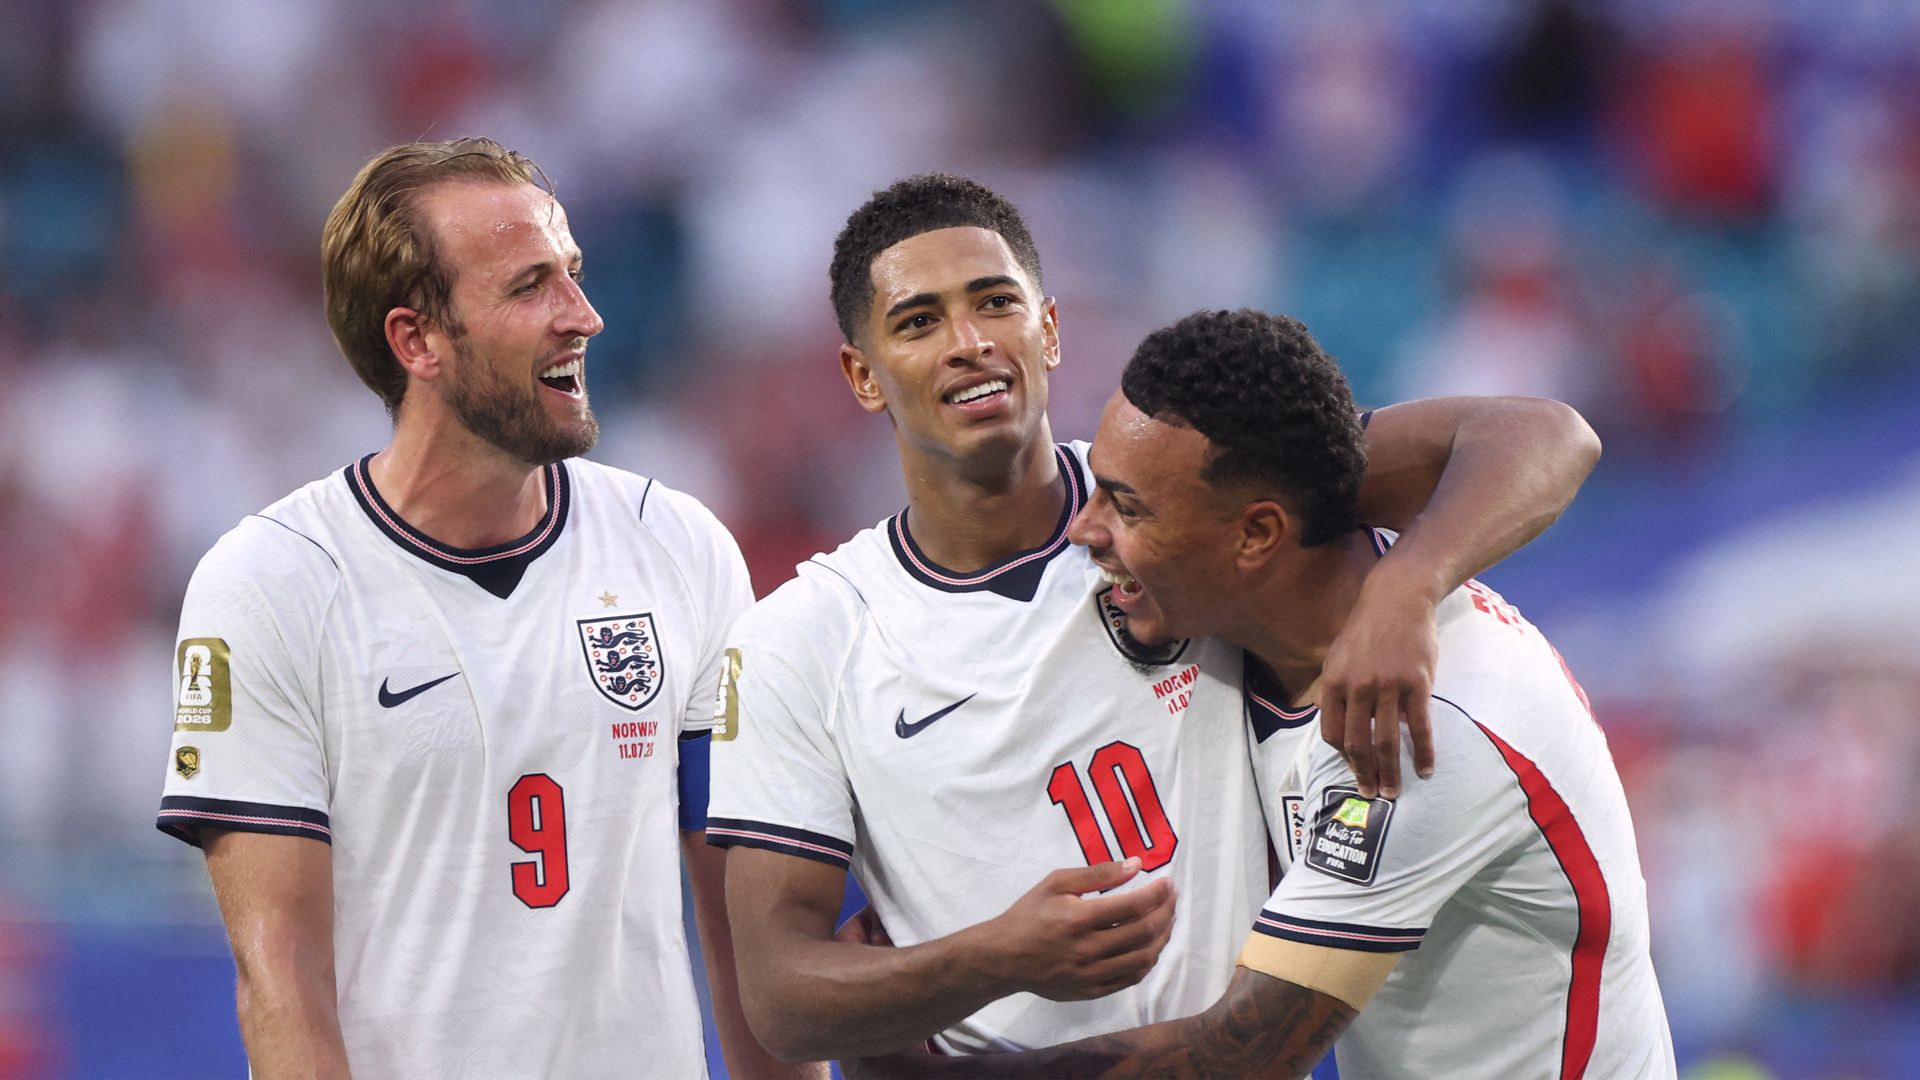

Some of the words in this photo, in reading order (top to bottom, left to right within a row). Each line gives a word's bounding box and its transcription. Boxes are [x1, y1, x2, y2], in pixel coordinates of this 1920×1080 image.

[177, 715, 212, 724] 2026
[612, 721, 658, 739] NORWAY
[1047, 740, 1178, 893] 10
[508, 773, 570, 909] 9
[1325, 822, 1350, 841] Unite
[1349, 830, 1365, 845] For
[1316, 836, 1368, 865] EDUCATION
[1326, 856, 1346, 870] FIFA
